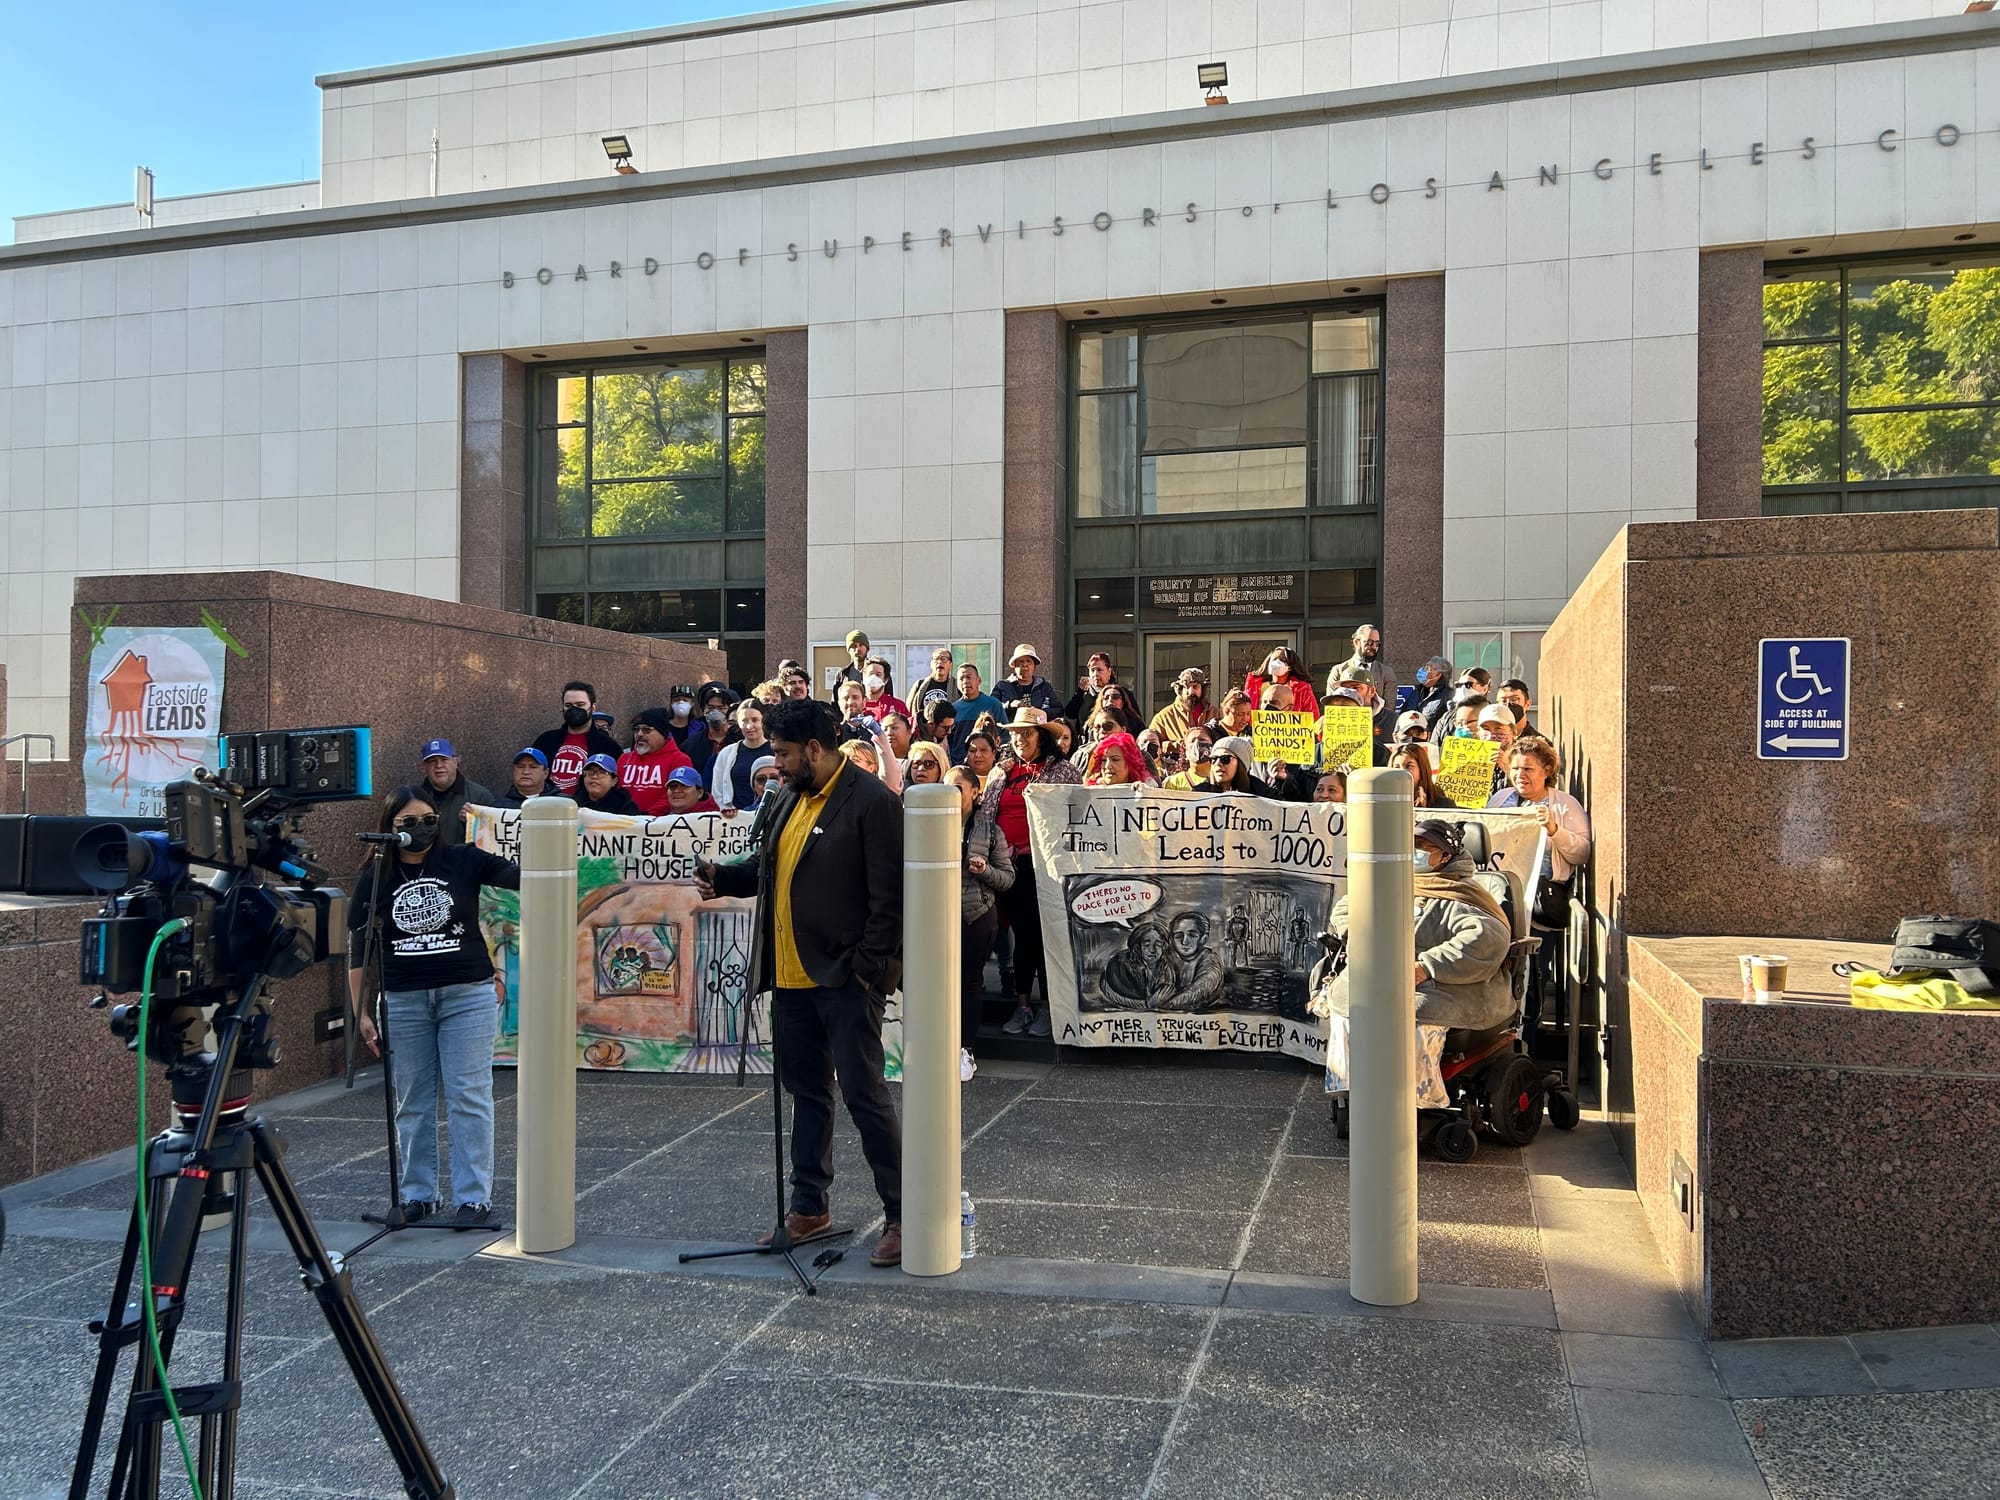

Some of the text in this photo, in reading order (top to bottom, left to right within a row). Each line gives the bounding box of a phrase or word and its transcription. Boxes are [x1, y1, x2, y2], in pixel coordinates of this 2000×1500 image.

[503, 124, 1961, 289] BOARD OF SUPERVISORS OF LOS ANGELES CO
[1150, 574, 1294, 591] COUNTY OF LOS ANGELES
[1154, 589, 1289, 604] BOARD OF SUPERVISORS
[1178, 604, 1264, 617] HEARING ROOM
[148, 683, 208, 707] Eastside
[146, 705, 206, 732] LEADS
[1257, 712, 1301, 725] LAND IN
[1779, 709, 1828, 718] ACCESS AT
[1254, 725, 1313, 739] COMMUNITY
[1765, 719, 1842, 729] SIDE OF BUILDING
[1260, 737, 1306, 749] HANDS!
[552, 758, 583, 776] UTLA
[1436, 782, 1487, 798] PEOPLE OF COLOR
[1438, 775, 1489, 790] LOW-INCOME
[1065, 804, 1103, 827] LA
[1121, 804, 1347, 837] NEGLECT from LA O
[645, 816, 698, 838] LA
[577, 834, 637, 857] NANT
[641, 838, 685, 858] BILL
[691, 839, 712, 854] OF
[1062, 832, 1108, 853] Times
[1158, 834, 1333, 868] Leads to 1000s
[1077, 891, 1151, 911] PLACE FOR US TO
[1062, 1023, 1076, 1040] A
[1079, 1019, 1142, 1036] MOTHER
[1157, 1018, 1220, 1031] STRUGGLES
[1229, 1020, 1248, 1031] TO
[1259, 1022, 1286, 1035] FIND
[1290, 1029, 1299, 1043] A
[1111, 1029, 1284, 1047] AFTER BEING EVICTED
